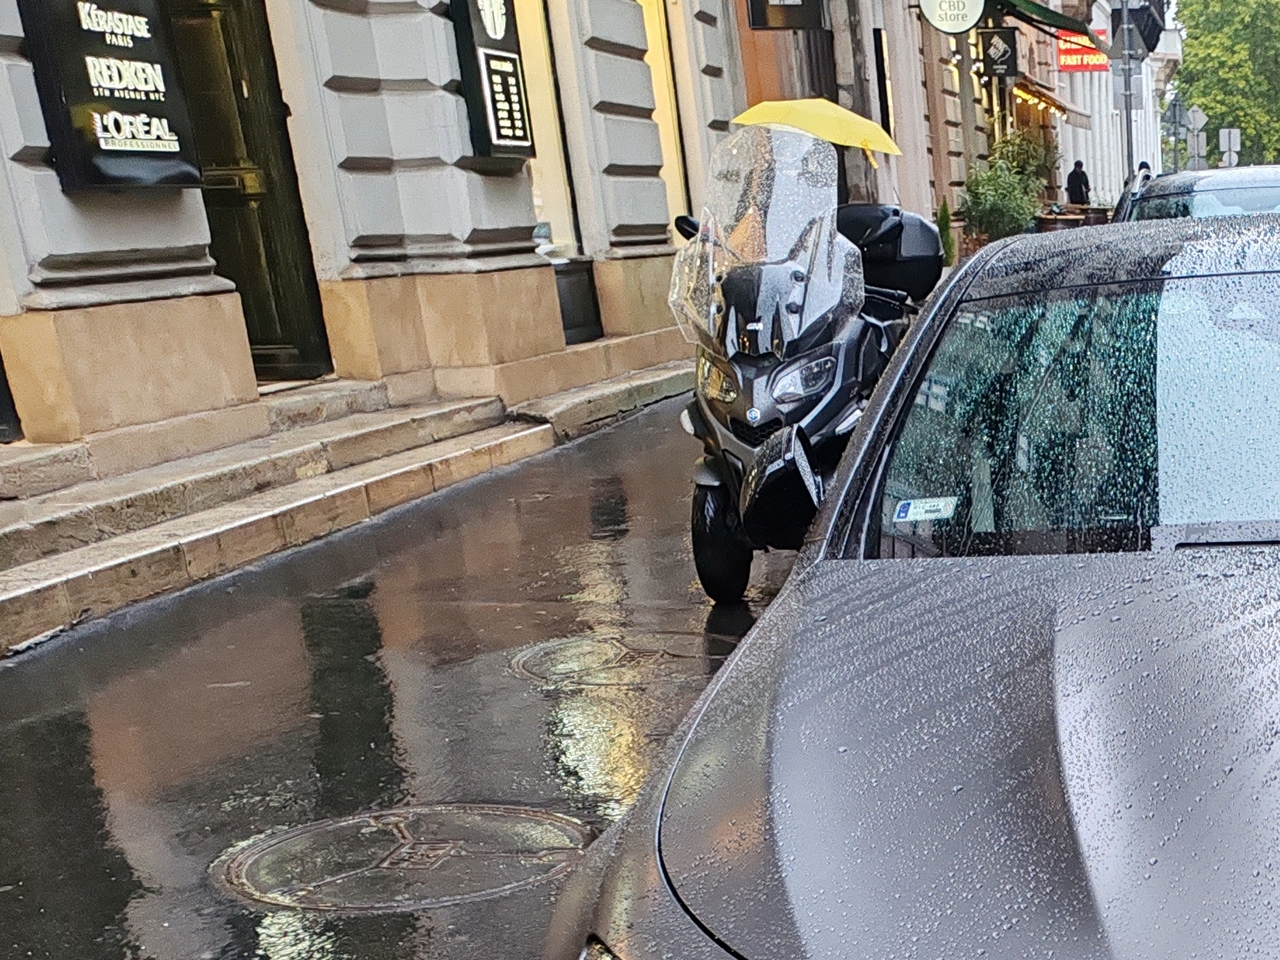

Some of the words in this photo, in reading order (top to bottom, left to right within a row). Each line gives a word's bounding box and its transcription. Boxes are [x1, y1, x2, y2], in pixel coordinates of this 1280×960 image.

[939, 0, 966, 12] CBD
[77, 1, 152, 38] KÉRASTASE
[938, 12, 968, 22] store
[105, 33, 134, 48] PARIS
[1060, 54, 1083, 65] FAST
[1083, 53, 1107, 65] FOOD
[85, 56, 166, 92] REDKEN
[114, 89, 147, 100] AVENUE
[92, 110, 178, 140] L'ORÉAL
[105, 140, 178, 150] PROFESSIONNEL
